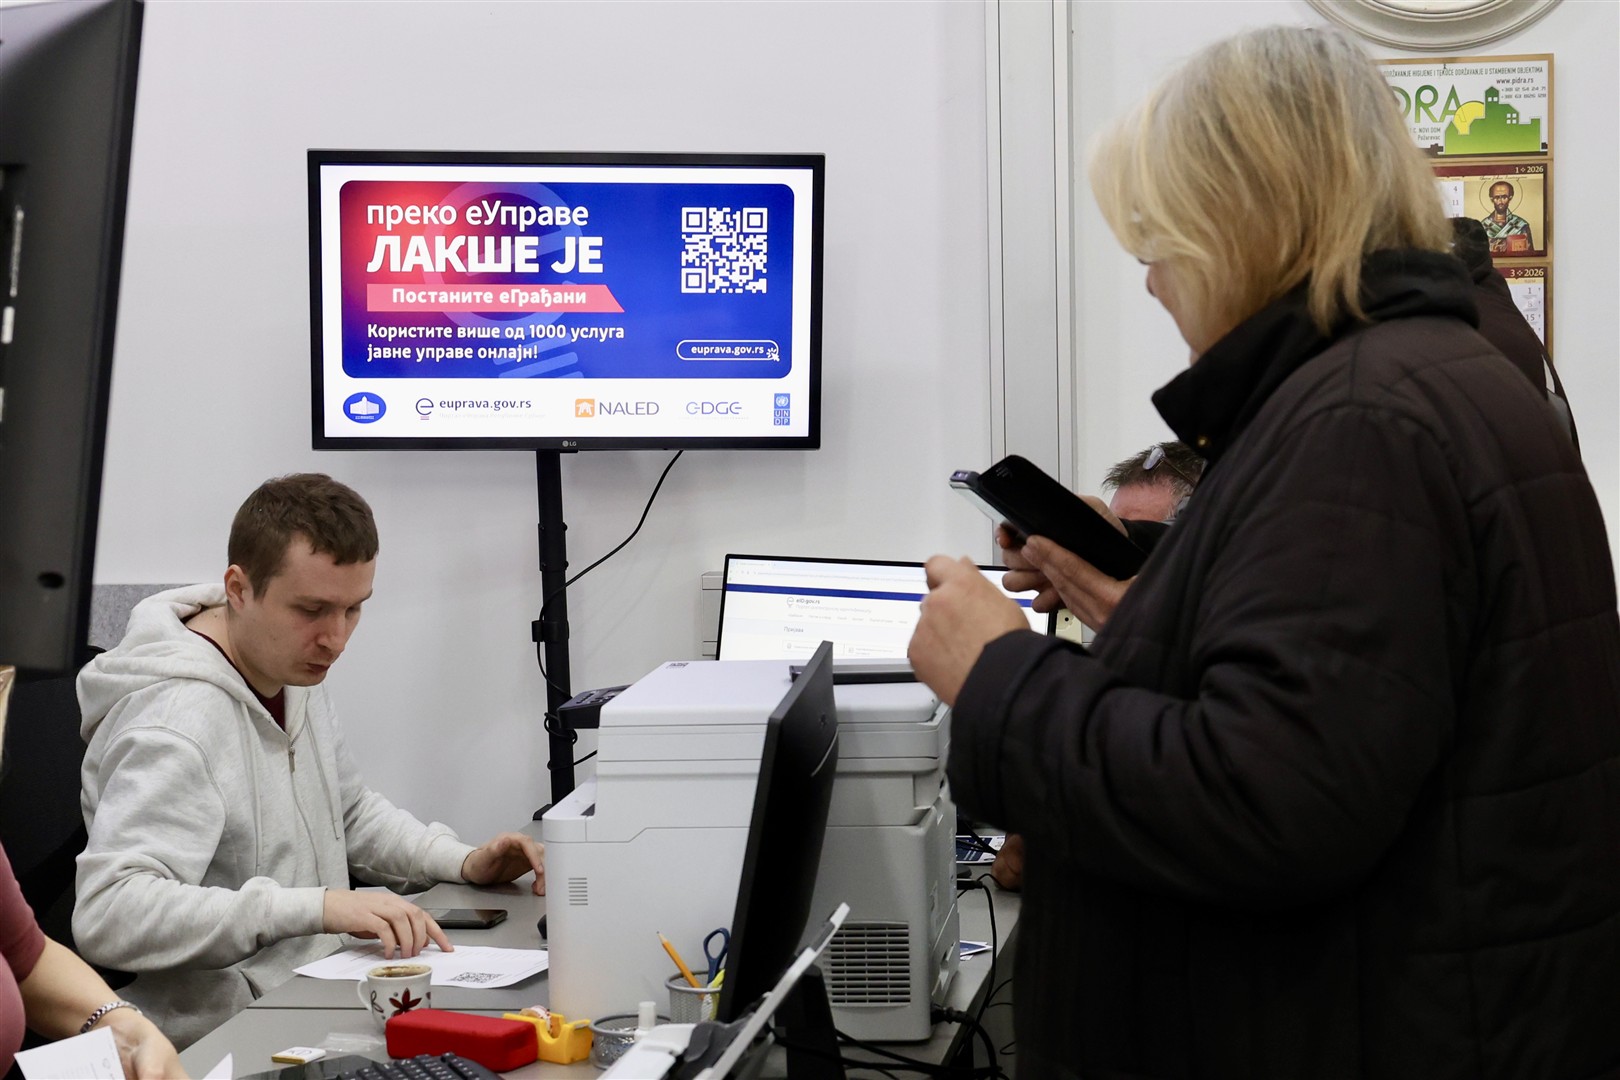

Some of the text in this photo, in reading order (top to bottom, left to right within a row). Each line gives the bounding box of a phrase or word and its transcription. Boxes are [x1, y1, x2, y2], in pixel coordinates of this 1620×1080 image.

[1412, 69, 1432, 77] HIGIJENE
[1455, 67, 1484, 76] ODRŽAVANJE
[1489, 67, 1516, 75] STAMBENIM
[1517, 66, 1543, 74] OBJEKTIMA
[1496, 77, 1534, 86] www.pidra.rs
[367, 200, 589, 232] преко еУправе
[366, 235, 604, 274] ЛАКШЕ ЈЕ
[1524, 268, 1544, 276] 2026
[392, 288, 587, 307] Постаните еГрађани
[367, 324, 625, 342] Користите више од 1000 услуга
[366, 344, 538, 362] јавне управе онлајн!
[691, 346, 764, 356] euprava.gov.rs
[439, 400, 532, 411] euprava.gov.rs
[600, 402, 659, 416] NALED
